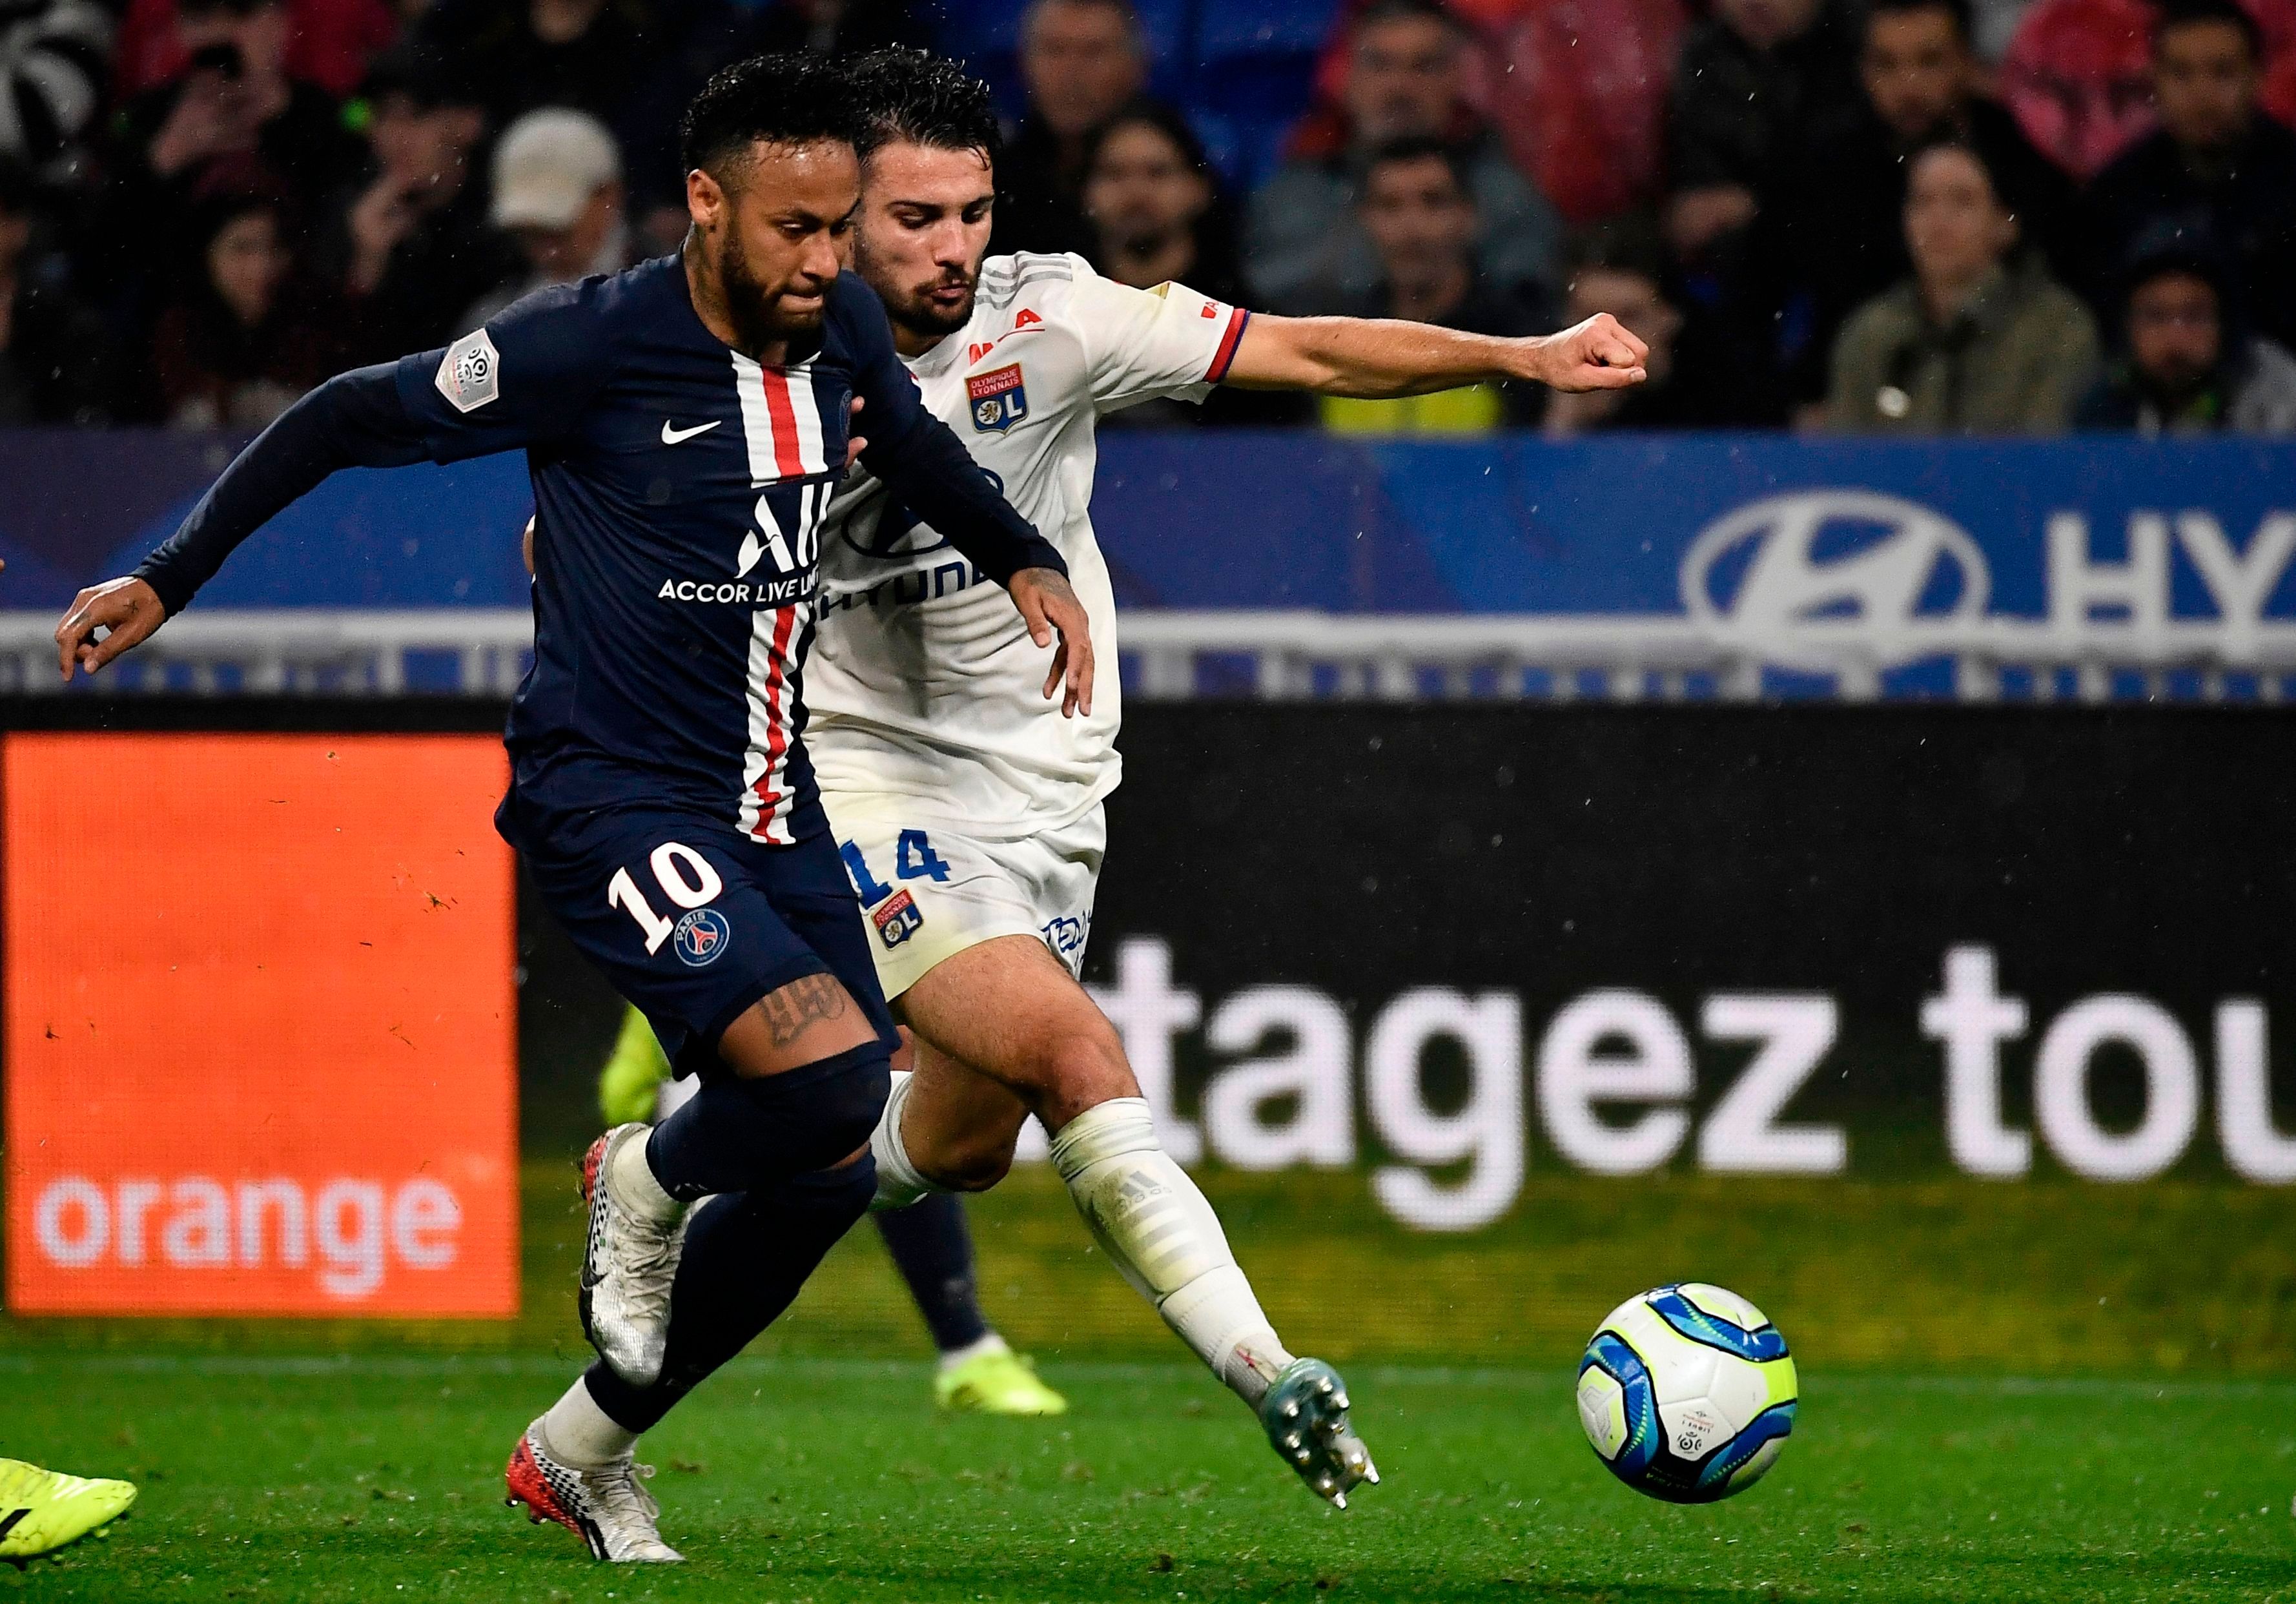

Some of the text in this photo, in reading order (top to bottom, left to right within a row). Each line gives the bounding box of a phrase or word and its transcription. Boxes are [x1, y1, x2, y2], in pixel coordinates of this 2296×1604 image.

[970, 368, 1018, 389] OLYMPIQUE
[972, 376, 1020, 397] LYONNAIS
[657, 579, 750, 604] ACCOR
[755, 579, 799, 602] LIVE
[840, 828, 952, 910] 14
[608, 841, 724, 957] 10
[677, 910, 706, 941] PARIS
[1086, 936, 1848, 1232] tagez
[34, 1175, 463, 1302] orange
